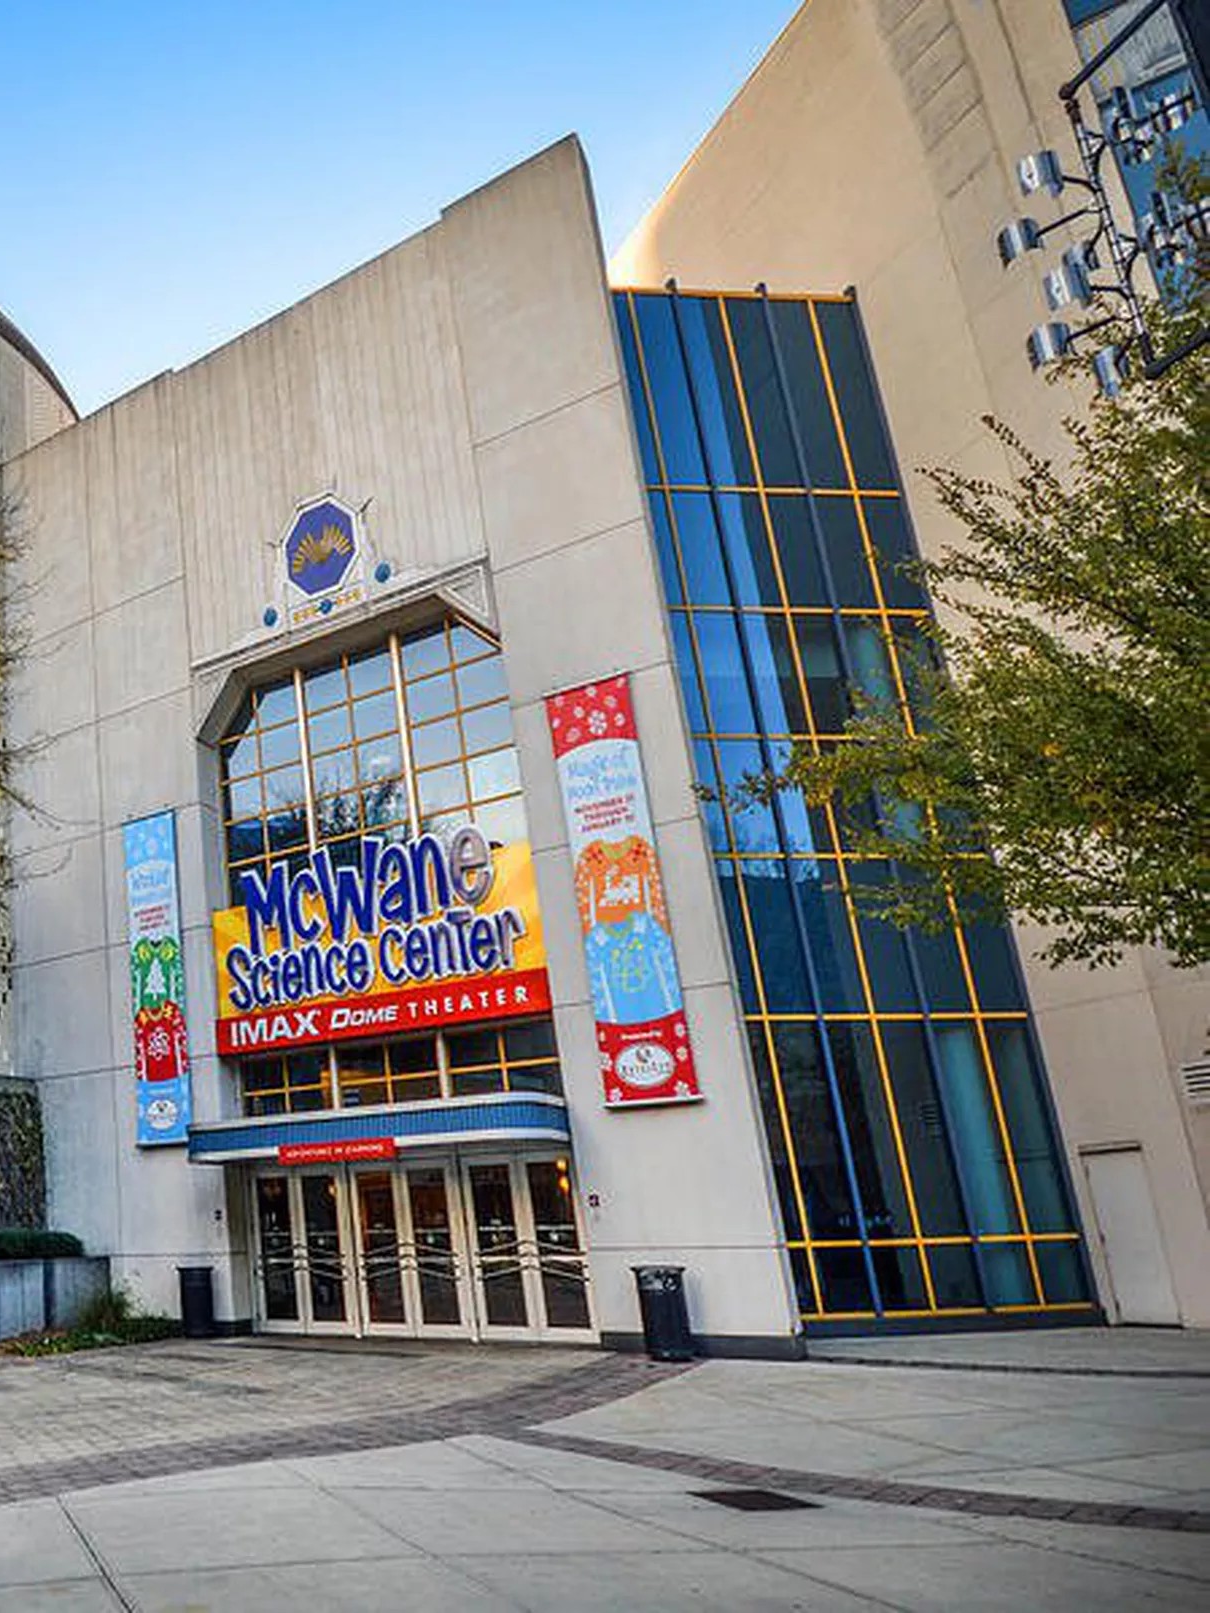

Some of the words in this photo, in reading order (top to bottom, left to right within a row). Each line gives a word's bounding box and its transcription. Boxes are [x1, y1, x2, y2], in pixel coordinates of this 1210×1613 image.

[240, 824, 495, 957] McWane
[226, 938, 374, 1011] Science
[230, 1011, 321, 1047] IMAX
[407, 985, 530, 1019] THEATER
